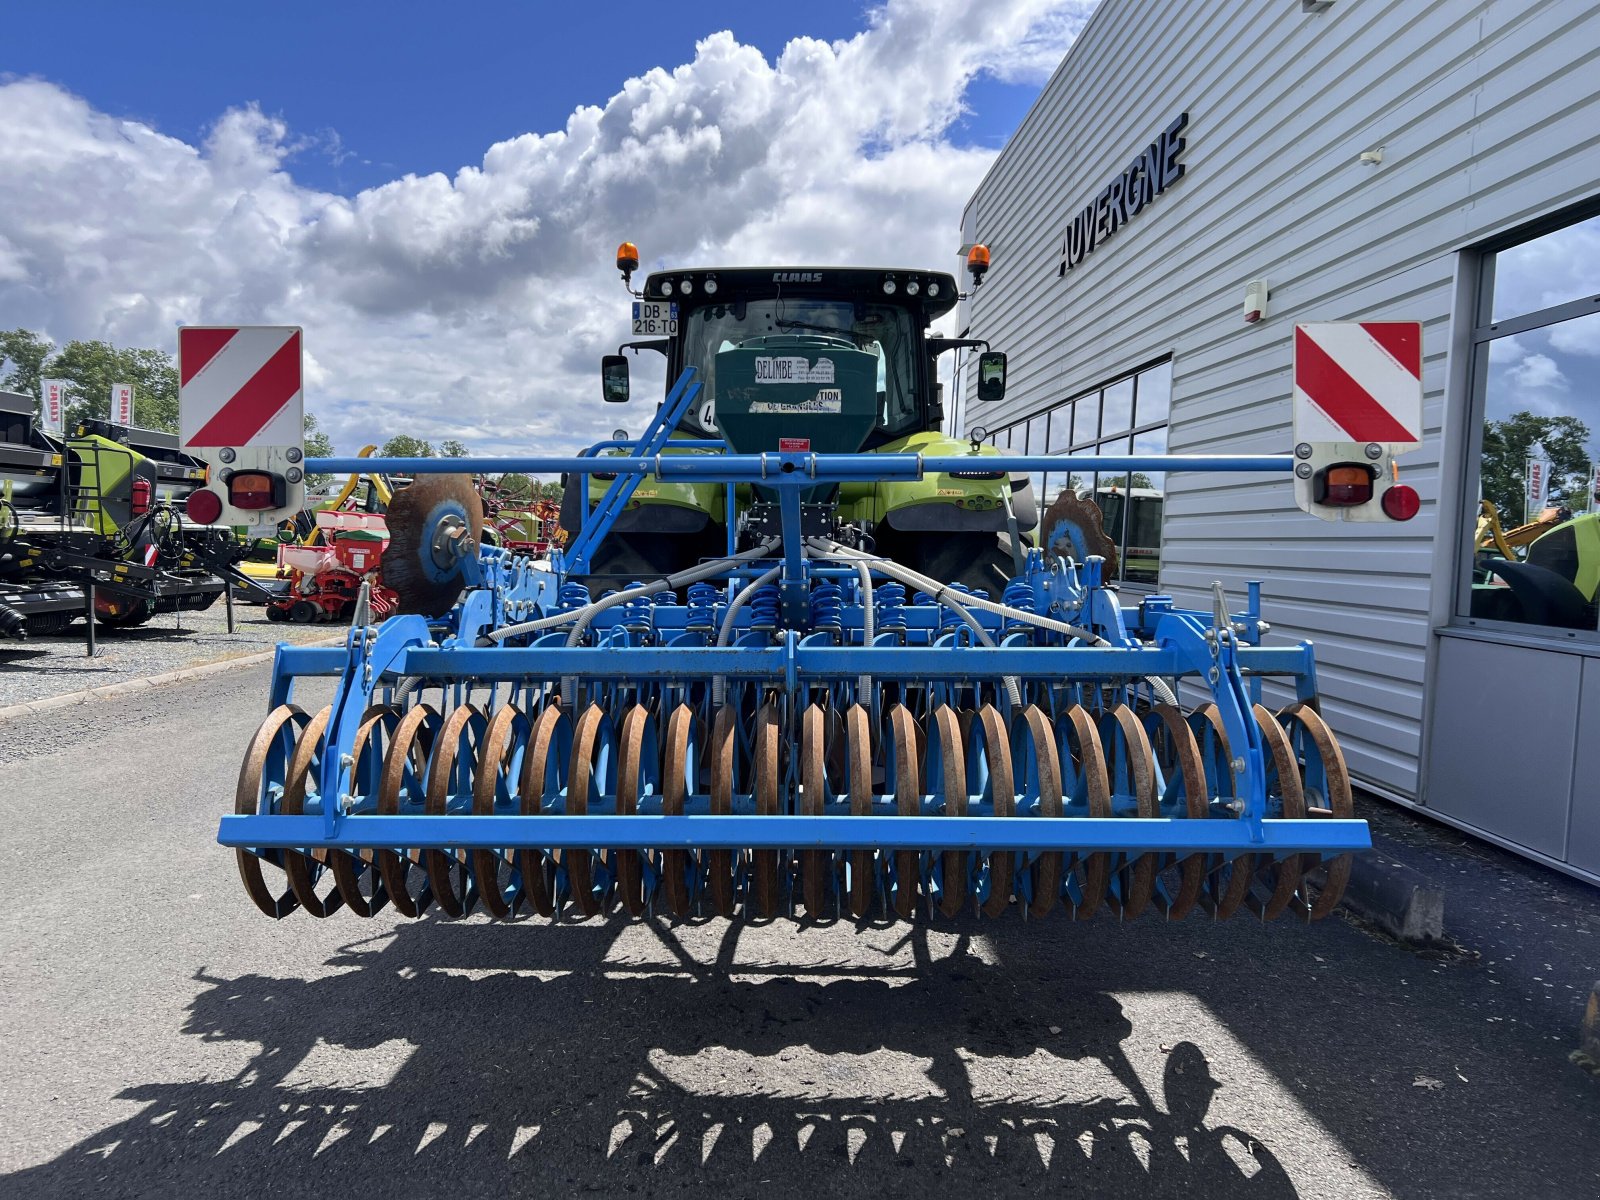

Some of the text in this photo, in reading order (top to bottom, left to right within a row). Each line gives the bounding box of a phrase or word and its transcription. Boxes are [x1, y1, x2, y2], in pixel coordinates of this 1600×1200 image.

[1058, 113, 1188, 277] AUVERGNE
[772, 272, 823, 283] CLAAS
[670, 311, 678, 319] 63
[634, 319, 677, 333] 216-TQ
[757, 360, 793, 380] DELIMBE
[704, 405, 717, 426] 4
